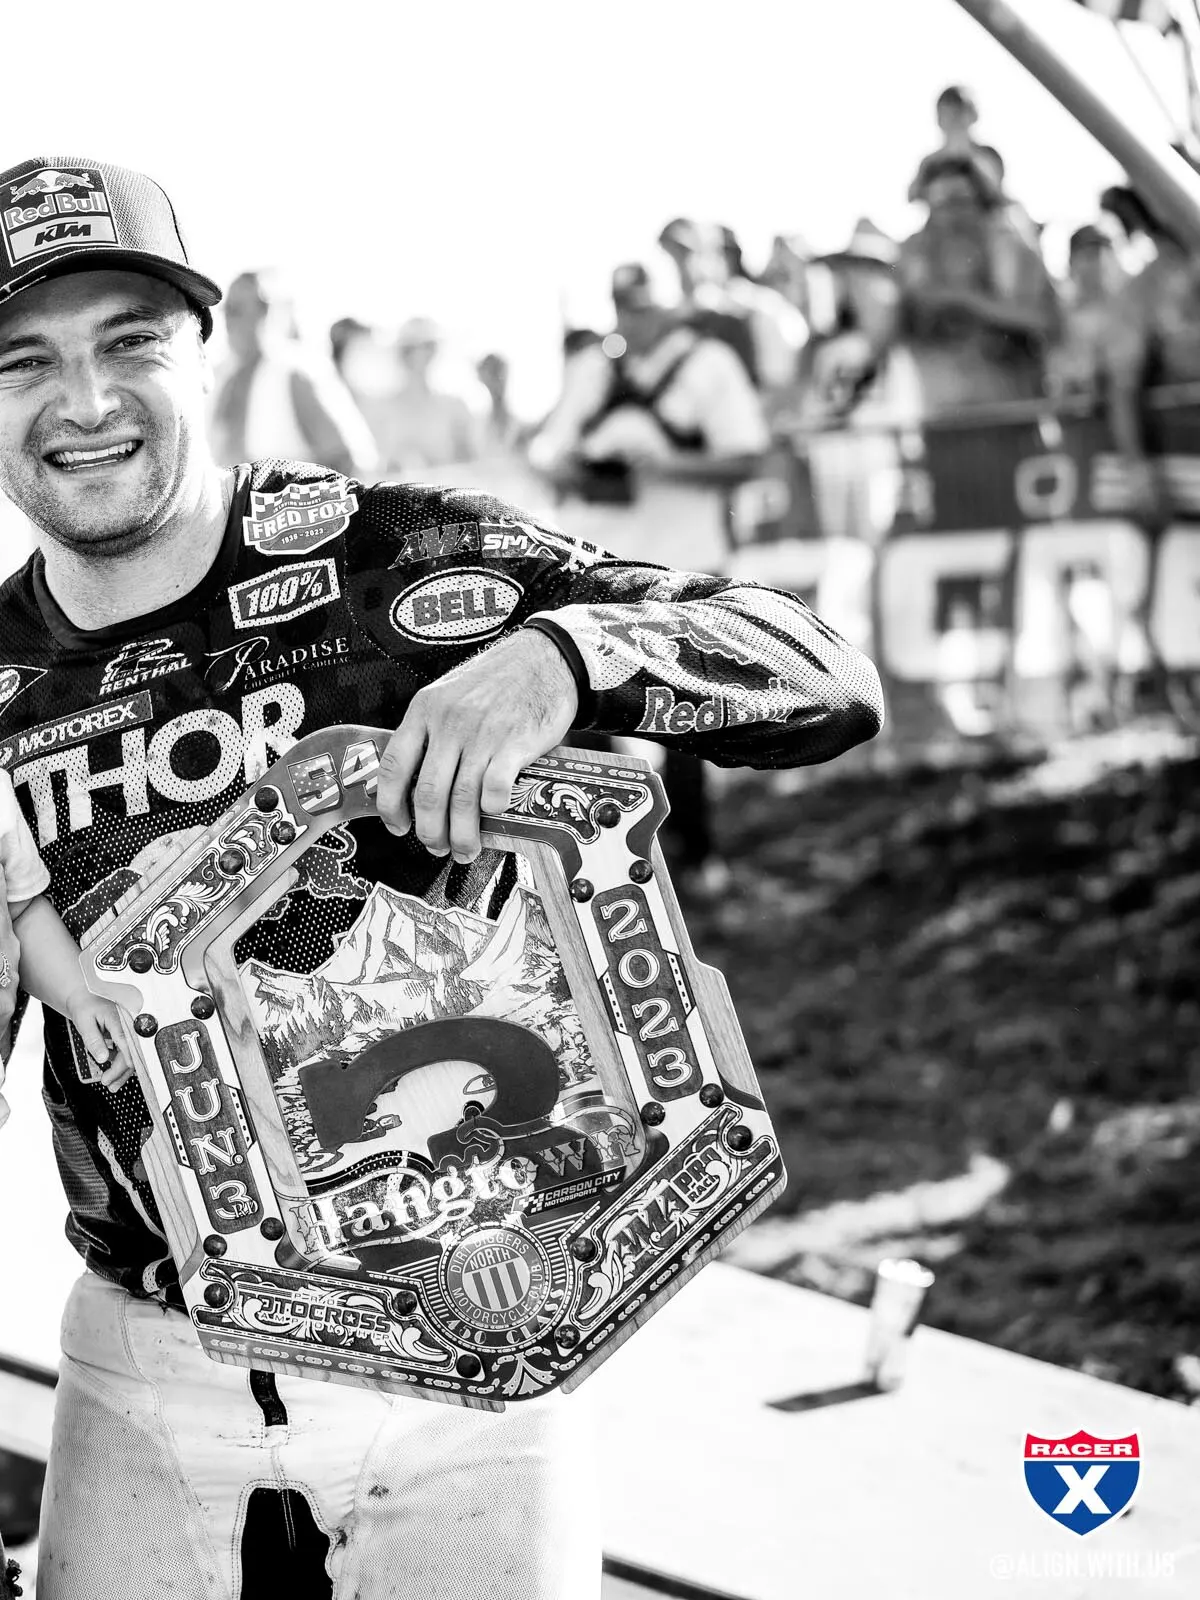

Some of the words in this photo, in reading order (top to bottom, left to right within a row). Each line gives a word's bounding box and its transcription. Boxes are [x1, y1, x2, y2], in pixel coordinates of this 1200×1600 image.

[3, 193, 57, 231] Red
[54, 191, 109, 213] Bull
[34, 221, 92, 246] KTM
[252, 510, 302, 539] FRED
[307, 501, 349, 524] FOX
[388, 521, 481, 570] AMA
[246, 569, 323, 617] 100%
[412, 587, 506, 627] BELL
[99, 658, 193, 697] RENTHAL
[204, 636, 350, 691] PARADISE
[18, 700, 138, 756] MOTOREX
[634, 686, 724, 734] Red
[13, 682, 305, 850] THOR
[600, 898, 693, 1089] 2023
[544, 1187, 597, 1208] MOTORSPORTS
[545, 1180, 593, 1201] CARSON
[595, 1171, 620, 1187] CITY
[451, 1245, 472, 1273] DIRT
[474, 1233, 530, 1255] DIGGERS
[469, 1247, 511, 1271] NORTH
[452, 1287, 533, 1324] MOTORCYCLE
[528, 1263, 544, 1299] CLUB
[446, 1318, 487, 1345] 450
[506, 1288, 565, 1345] CLASS
